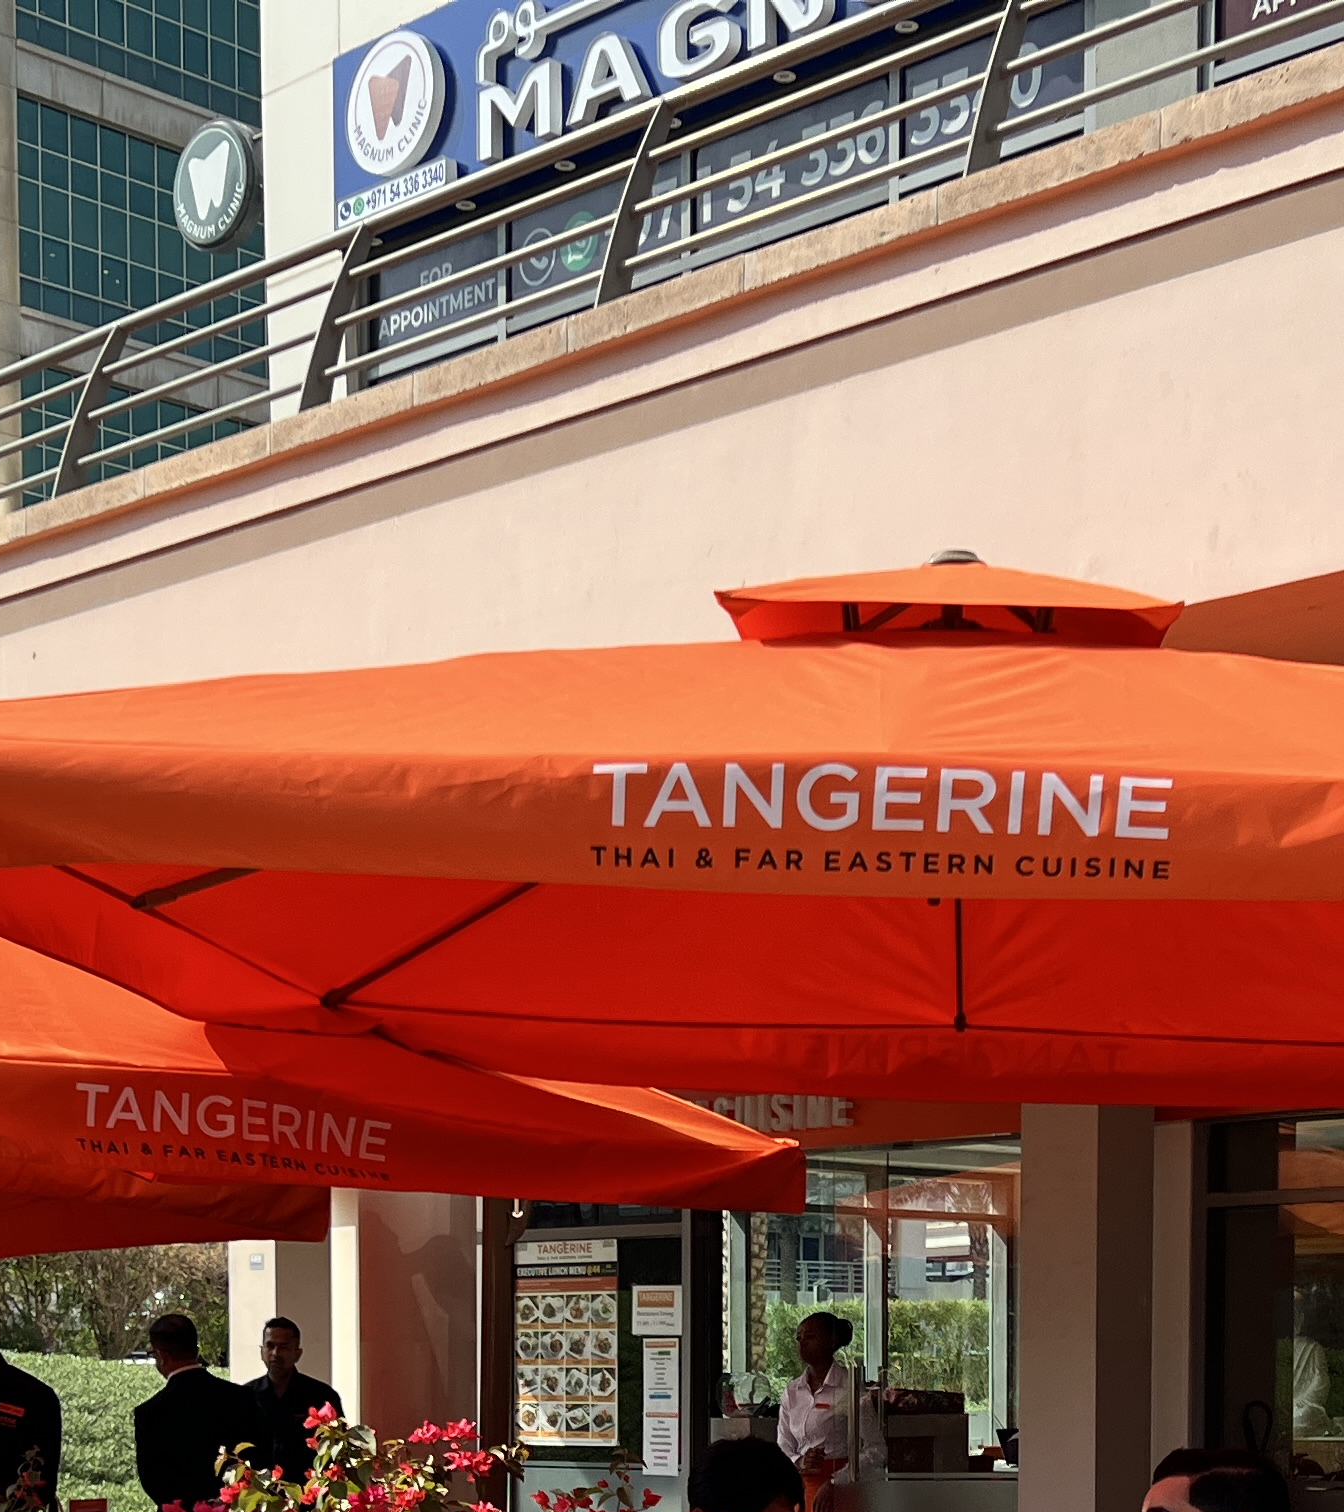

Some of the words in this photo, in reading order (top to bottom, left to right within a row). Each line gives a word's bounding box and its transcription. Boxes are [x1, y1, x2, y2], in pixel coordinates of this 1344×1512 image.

[476, 0, 836, 163] MAGN
[910, 41, 1043, 146] 330
[353, 124, 394, 162] MAGNUM
[397, 98, 427, 153] CLINIC
[176, 202, 215, 239] MAGNUM
[218, 181, 244, 231] CLINIC
[366, 186, 386, 210] +971
[390, 181, 400, 202] 54
[403, 174, 419, 197] 336
[422, 163, 444, 189] 3340
[419, 261, 453, 290] FOR
[378, 277, 496, 341] APPOINTMENT
[592, 762, 1175, 840] TANGERINE
[590, 845, 676, 869] THAI
[695, 847, 714, 869] &
[734, 848, 804, 872] FAR
[824, 850, 995, 876] EASTERN
[1015, 855, 1172, 880] CUISINE
[75, 1082, 393, 1163] TANGERINE
[74, 1137, 129, 1155] THAI
[141, 1142, 153, 1156] &
[163, 1144, 206, 1160] FAR
[216, 1150, 306, 1172] EASTERN
[313, 1162, 392, 1183] CUISINE
[537, 1242, 593, 1254] TANGERINE
